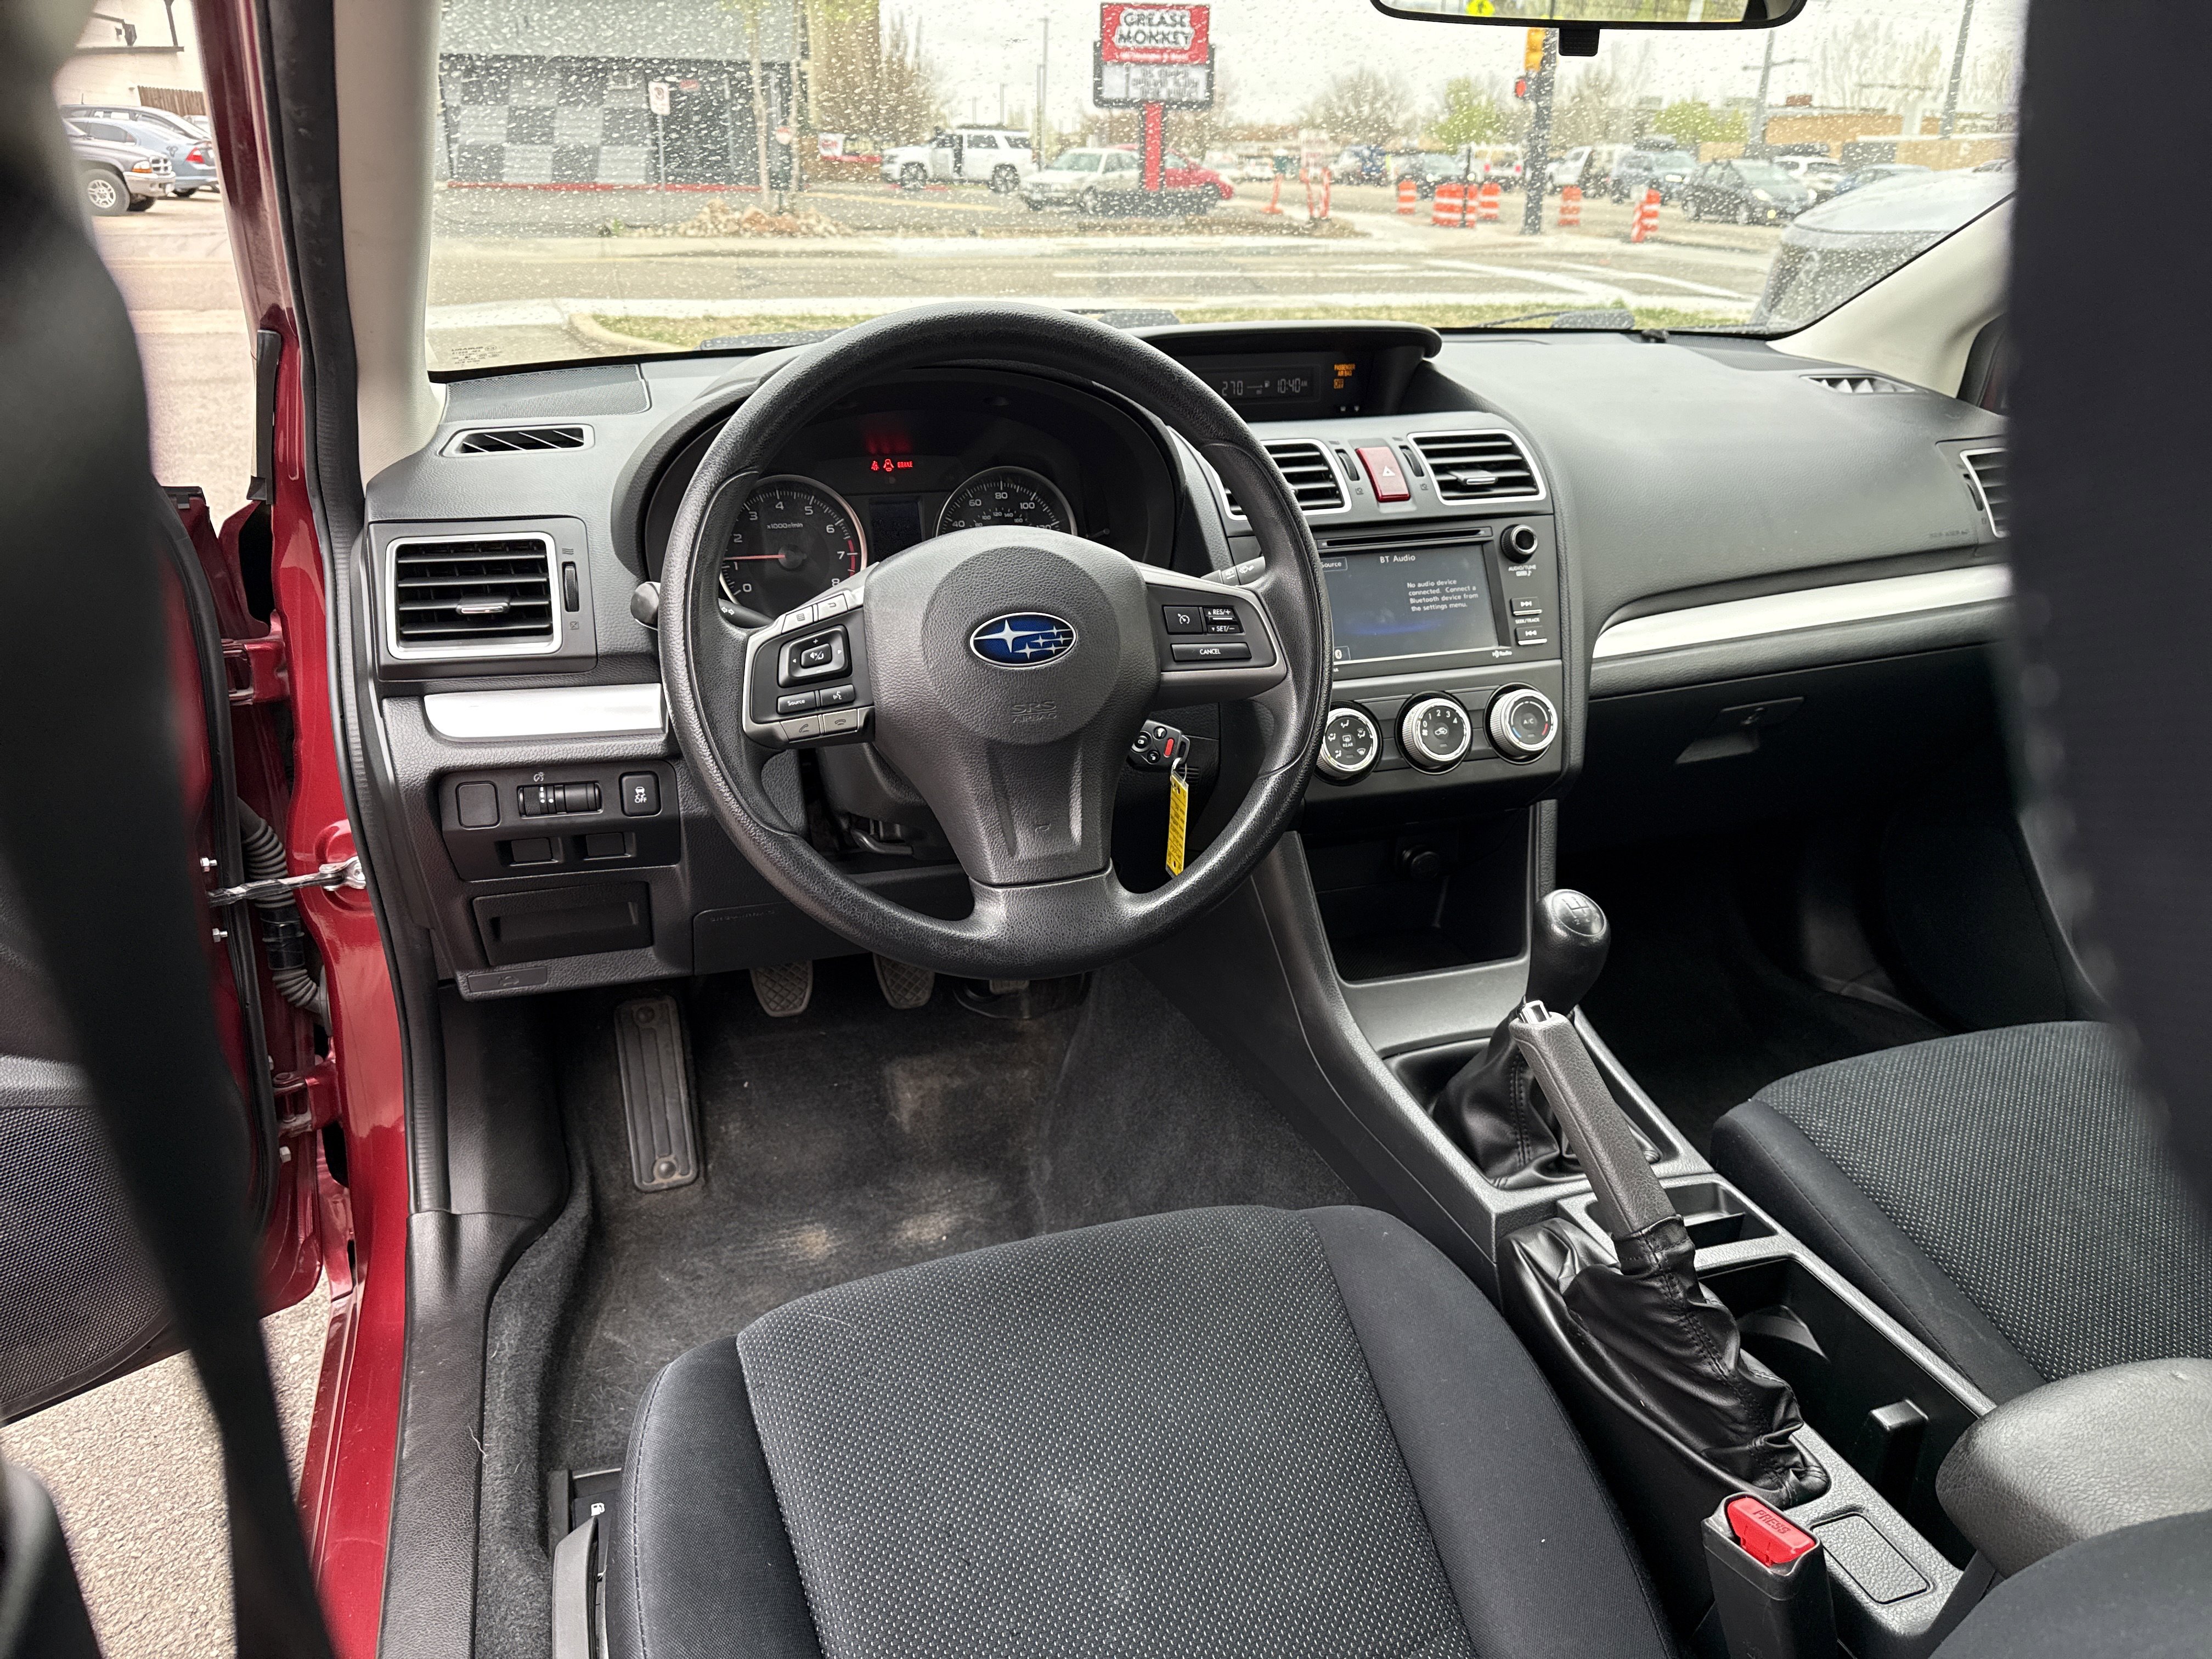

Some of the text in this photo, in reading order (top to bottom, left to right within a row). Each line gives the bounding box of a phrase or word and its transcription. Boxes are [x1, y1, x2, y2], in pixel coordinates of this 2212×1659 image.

[1124, 12, 1190, 27] GREASE
[1117, 30, 1192, 44] MONKEY
[1222, 381, 1243, 396] 270
[1277, 378, 1301, 394] 10:40
[995, 492, 1008, 500] 80
[775, 501, 785, 510] 4
[969, 499, 981, 507] 60
[804, 506, 814, 516] 5
[748, 511, 758, 521] 3
[826, 524, 835, 534] 6
[733, 534, 743, 543] 2
[837, 551, 845, 560] 7
[1379, 554, 1416, 563] BT Audio
[733, 561, 738, 571] 1
[831, 578, 840, 587] 8
[742, 583, 752, 592] 0
[1408, 588, 1441, 596] connected.
[1409, 595, 1440, 604] Bluetooth
[1012, 700, 1057, 714] SRS
[1436, 709, 1441, 718] 2
[1752, 1509, 1792, 1534] PRESS
